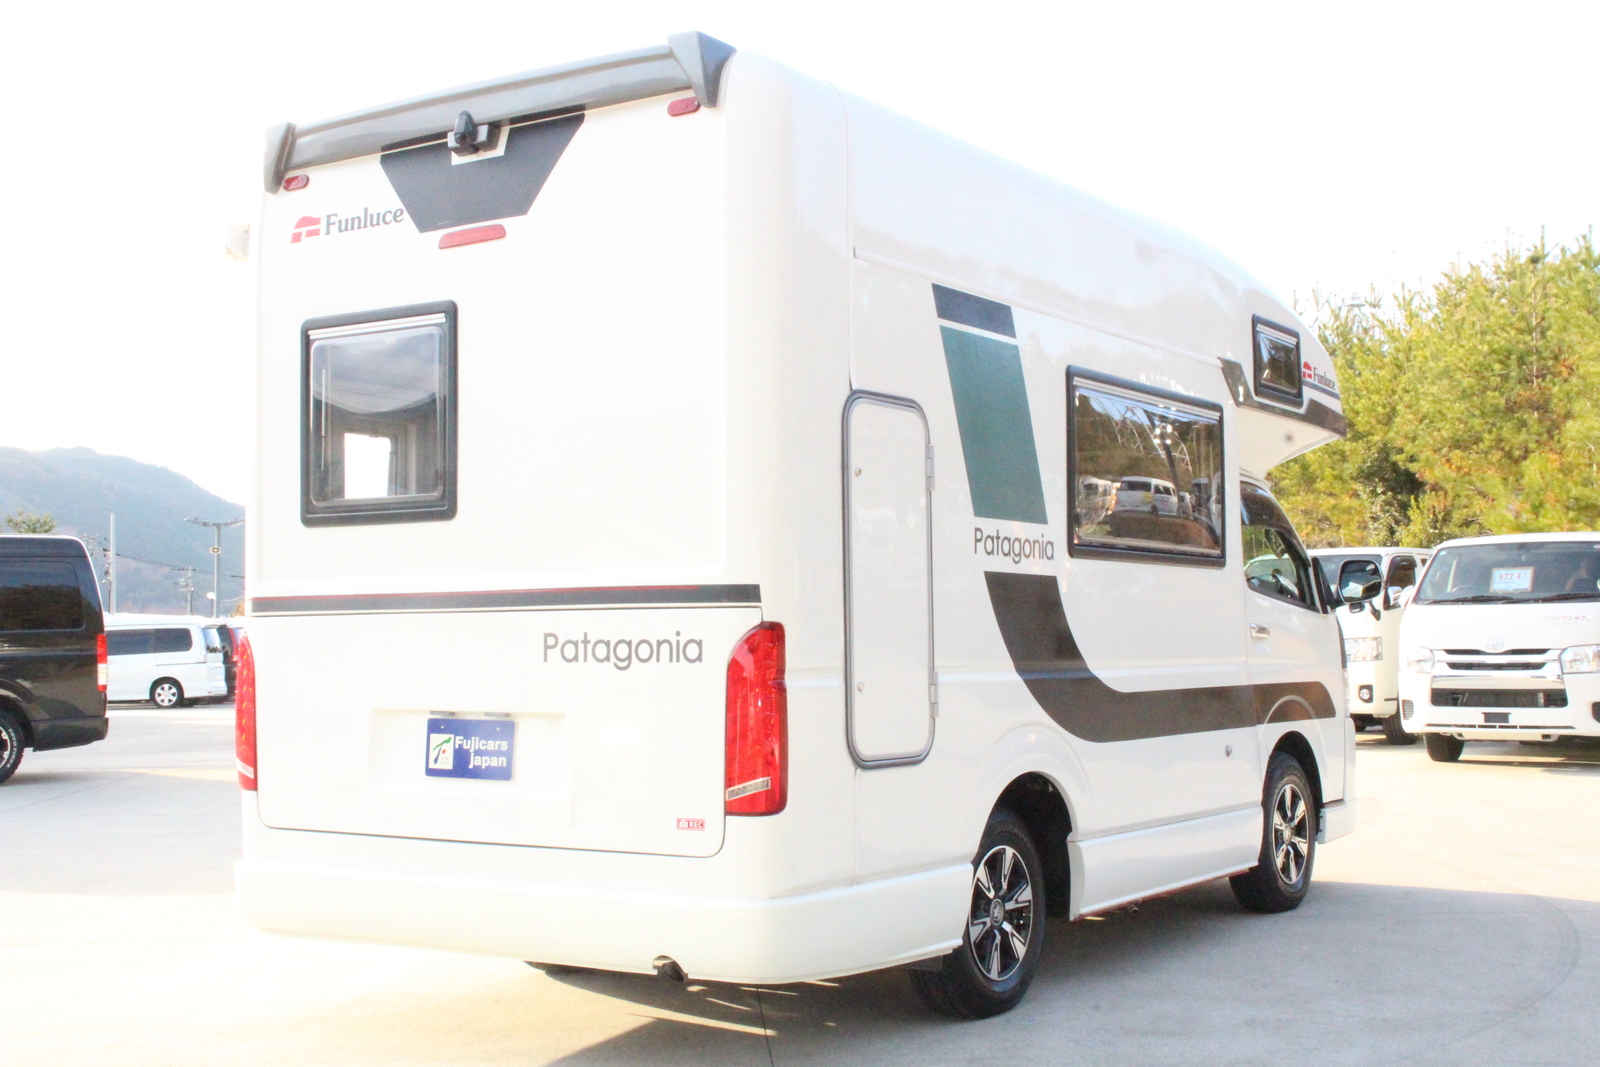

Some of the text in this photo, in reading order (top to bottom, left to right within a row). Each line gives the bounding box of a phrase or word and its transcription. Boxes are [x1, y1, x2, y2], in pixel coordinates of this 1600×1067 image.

[324, 207, 405, 236] Funluce
[1313, 366, 1336, 391] Funluce
[973, 527, 1055, 565] Patagonia
[542, 630, 704, 671] Patagonia
[454, 735, 509, 753] Fujicars
[468, 752, 507, 769] japan
[689, 820, 703, 829] REC
